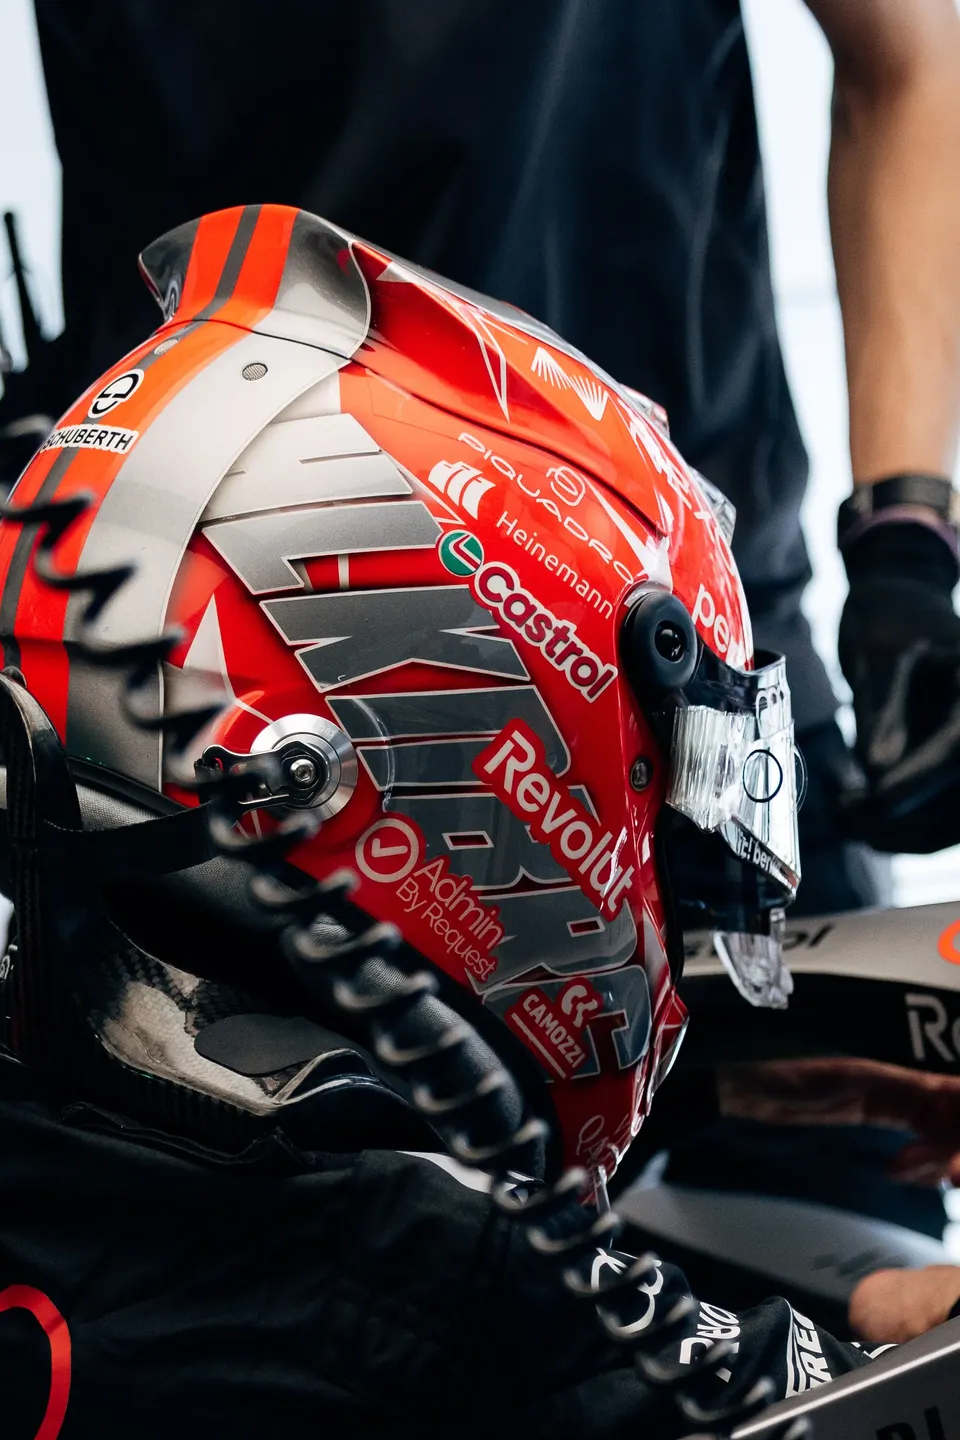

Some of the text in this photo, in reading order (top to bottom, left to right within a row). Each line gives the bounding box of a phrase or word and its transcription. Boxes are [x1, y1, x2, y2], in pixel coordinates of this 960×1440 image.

[42, 428, 134, 451] SCHUBERTH
[457, 431, 634, 586] PIQUADRO
[495, 509, 614, 620] Heinemann
[476, 562, 617, 702] Castrol
[483, 730, 635, 914] Revolut
[396, 879, 496, 982] By Request
[414, 857, 505, 950] Admin
[522, 993, 586, 1067] CAMOZZI
[904, 993, 960, 1063] R
